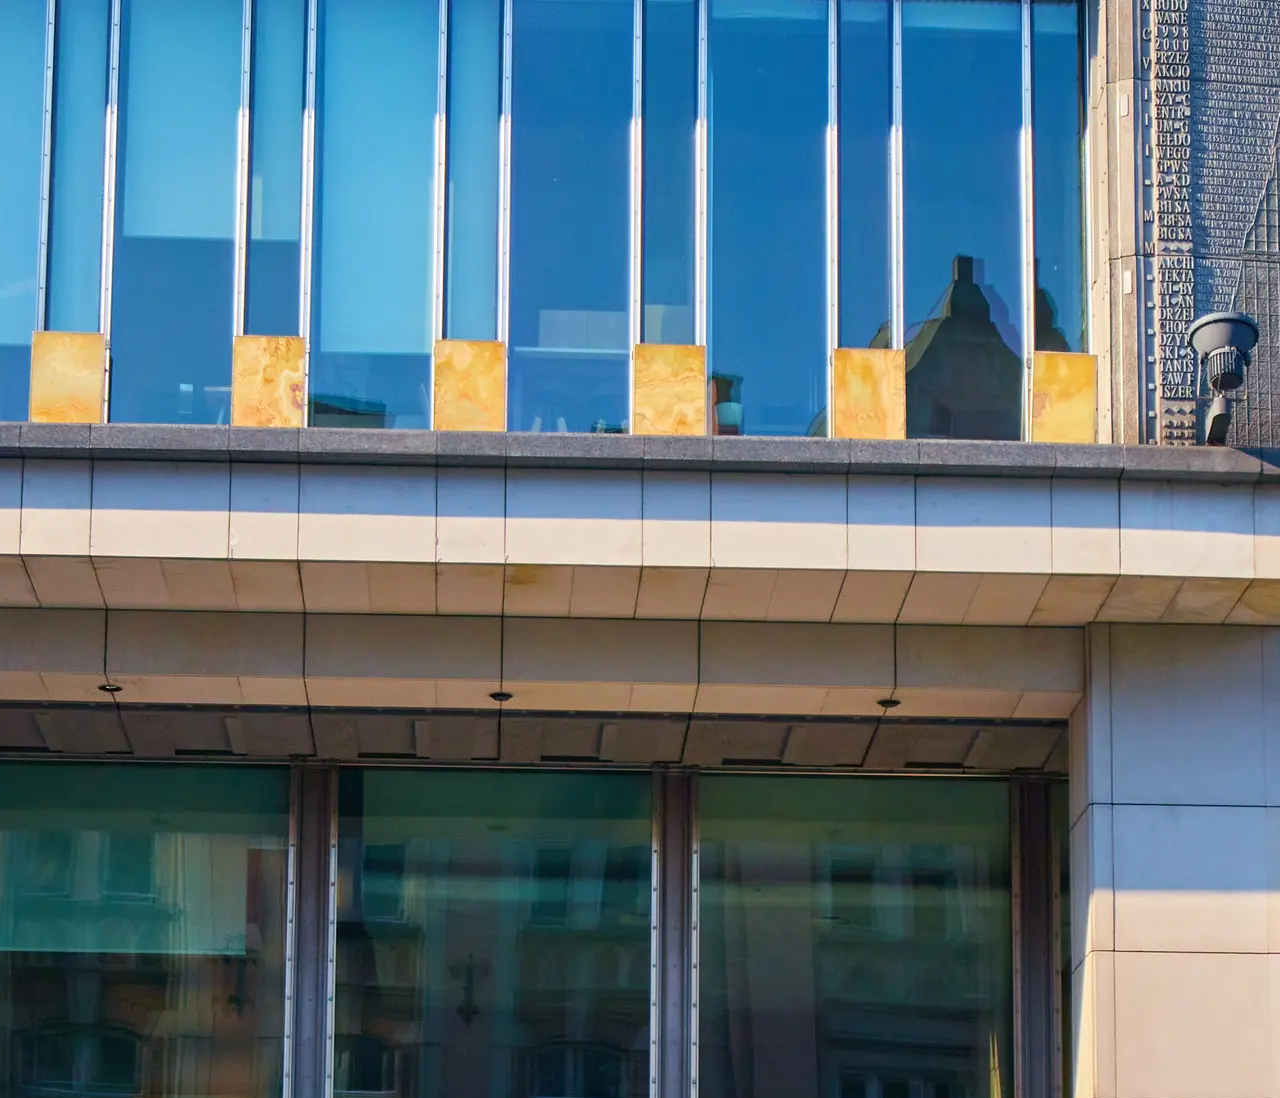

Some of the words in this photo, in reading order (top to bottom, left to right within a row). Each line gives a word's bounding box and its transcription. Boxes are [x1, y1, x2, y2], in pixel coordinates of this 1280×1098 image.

[1155, 12, 1189, 25] WANE
[1155, 39, 1189, 51] 2000
[1155, 52, 1190, 64] PRZEZ
[1156, 147, 1190, 160] WEGO
[1158, 257, 1195, 269] ARCHI
[1158, 270, 1195, 282] TEKTA
